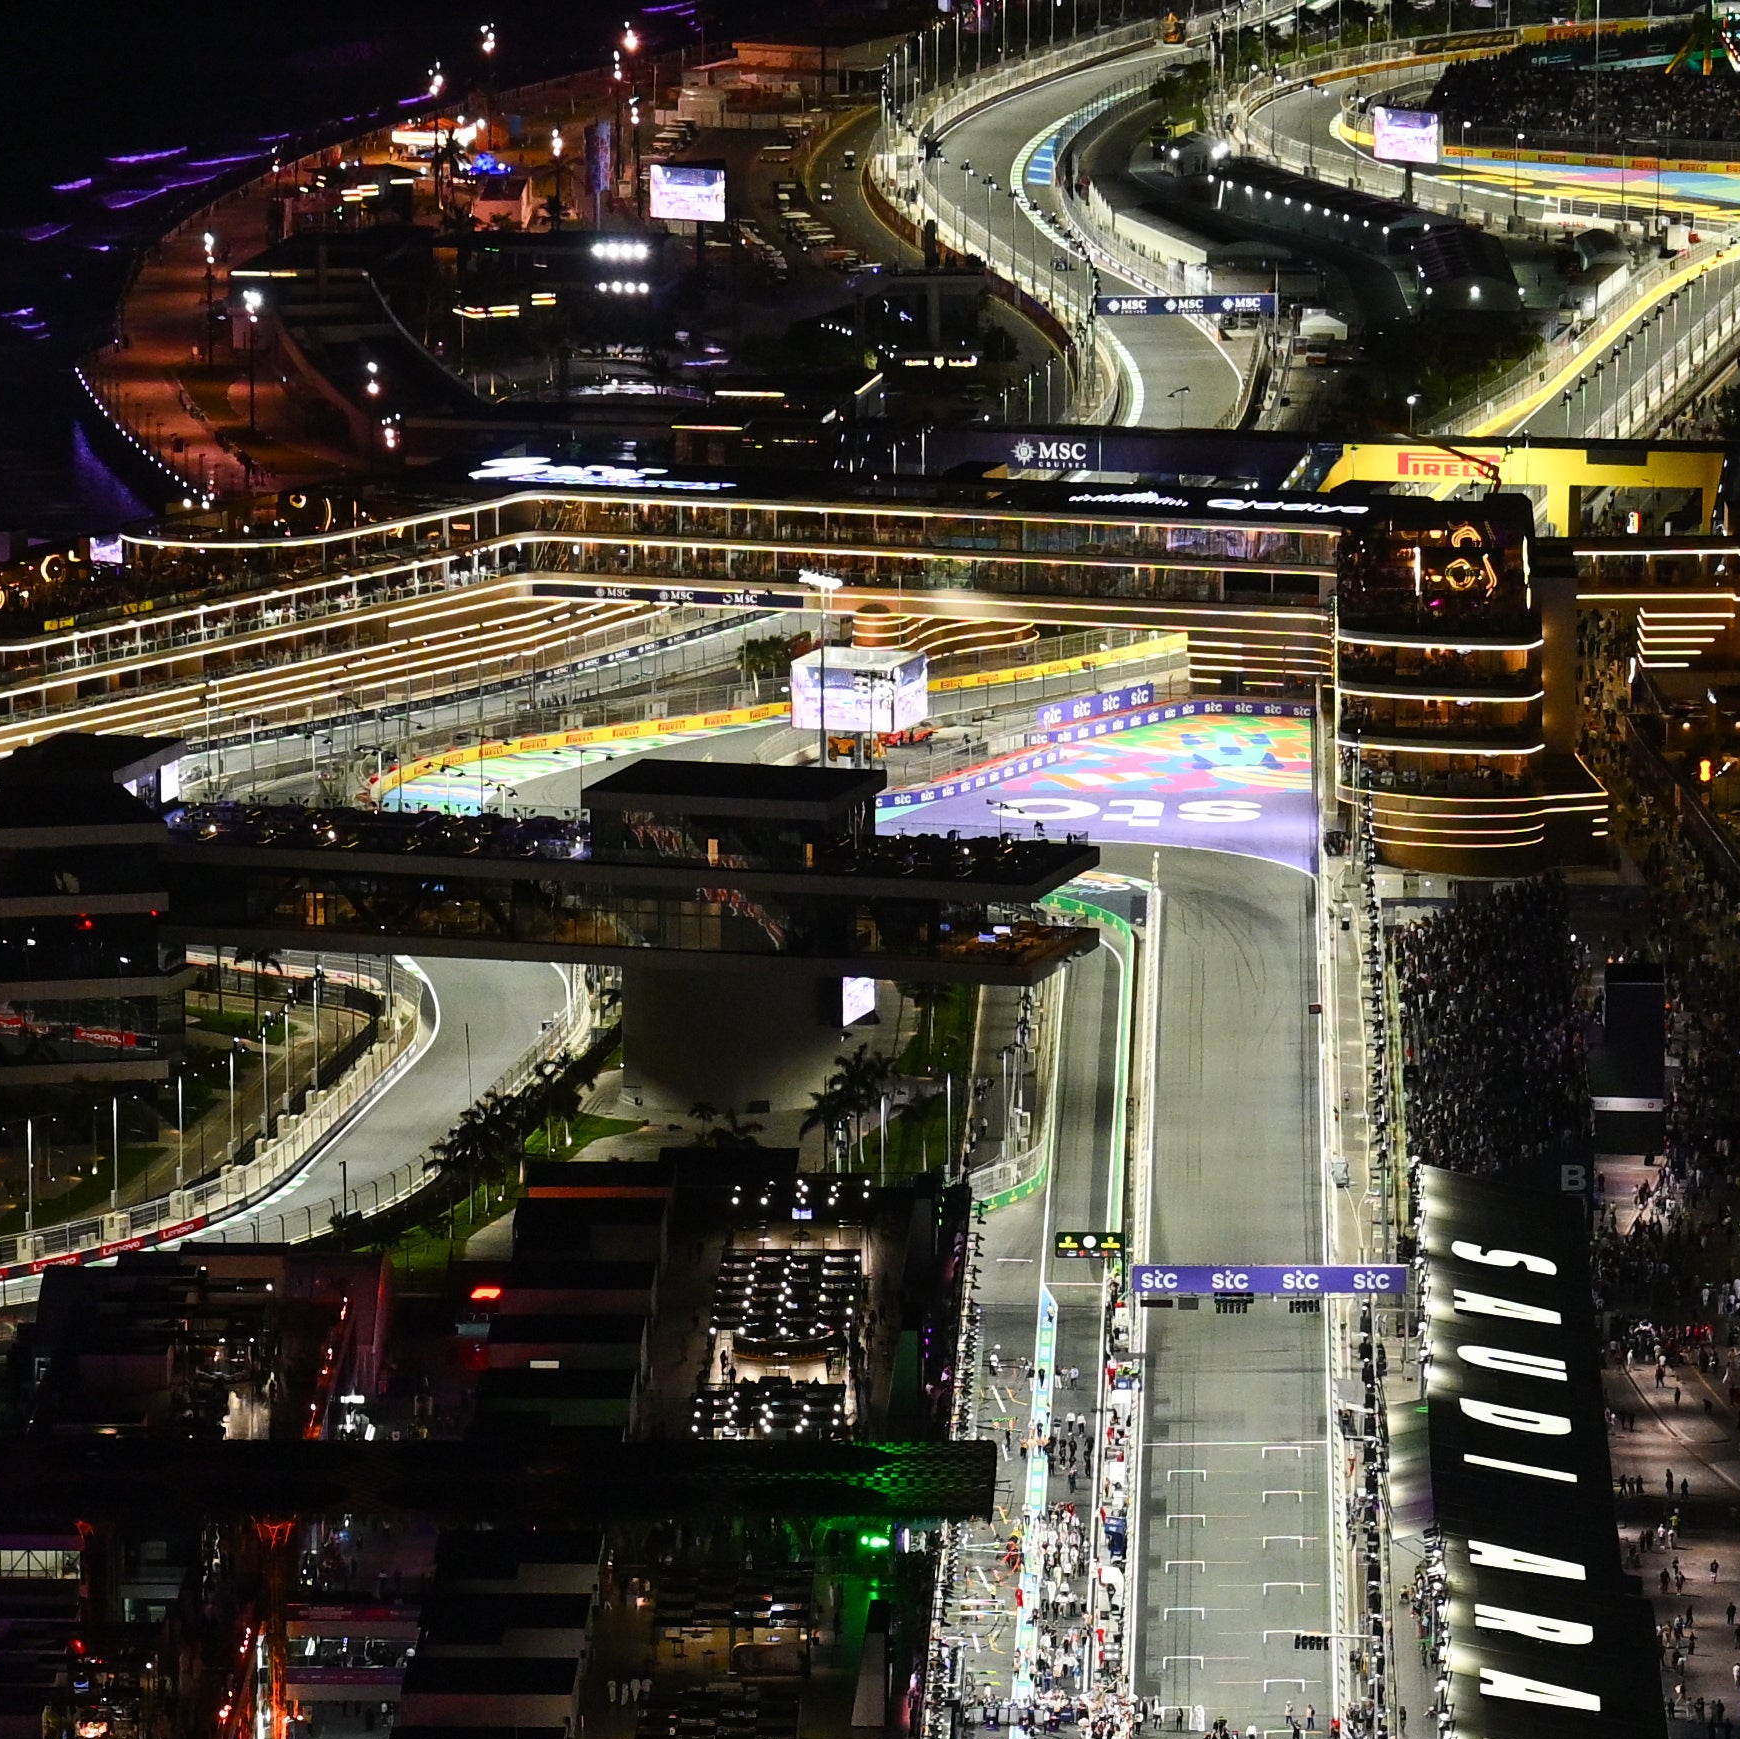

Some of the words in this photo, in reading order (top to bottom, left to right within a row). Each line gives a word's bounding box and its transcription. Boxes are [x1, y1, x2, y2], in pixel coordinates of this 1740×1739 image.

[1121, 300, 1147, 309] MSC
[1178, 299, 1204, 309] MSC
[1235, 298, 1261, 307] MSC
[1038, 442, 1088, 460] MSC
[607, 588, 631, 598] MSC
[670, 591, 694, 600] MSC
[734, 594, 758, 604] MSC
[1131, 687, 1149, 706] stc
[1073, 700, 1091, 719] stc
[1102, 694, 1120, 713] stc
[1204, 701, 1223, 713] stc
[1235, 701, 1253, 714] stc
[1264, 703, 1282, 715] stc
[1293, 706, 1311, 717] stc
[1031, 734, 1048, 745] stc
[921, 790, 935, 802] stc
[942, 786, 955, 797] stc
[894, 794, 911, 804] stc
[1561, 1164, 1587, 1191] B
[102, 1240, 140, 1256] Lenovo
[1141, 1269, 1178, 1289] stc
[1211, 1269, 1249, 1290] stc
[1282, 1269, 1320, 1290] stc
[1353, 1269, 1391, 1290] stc
[1451, 1240, 1578, 1483] SAUDI
